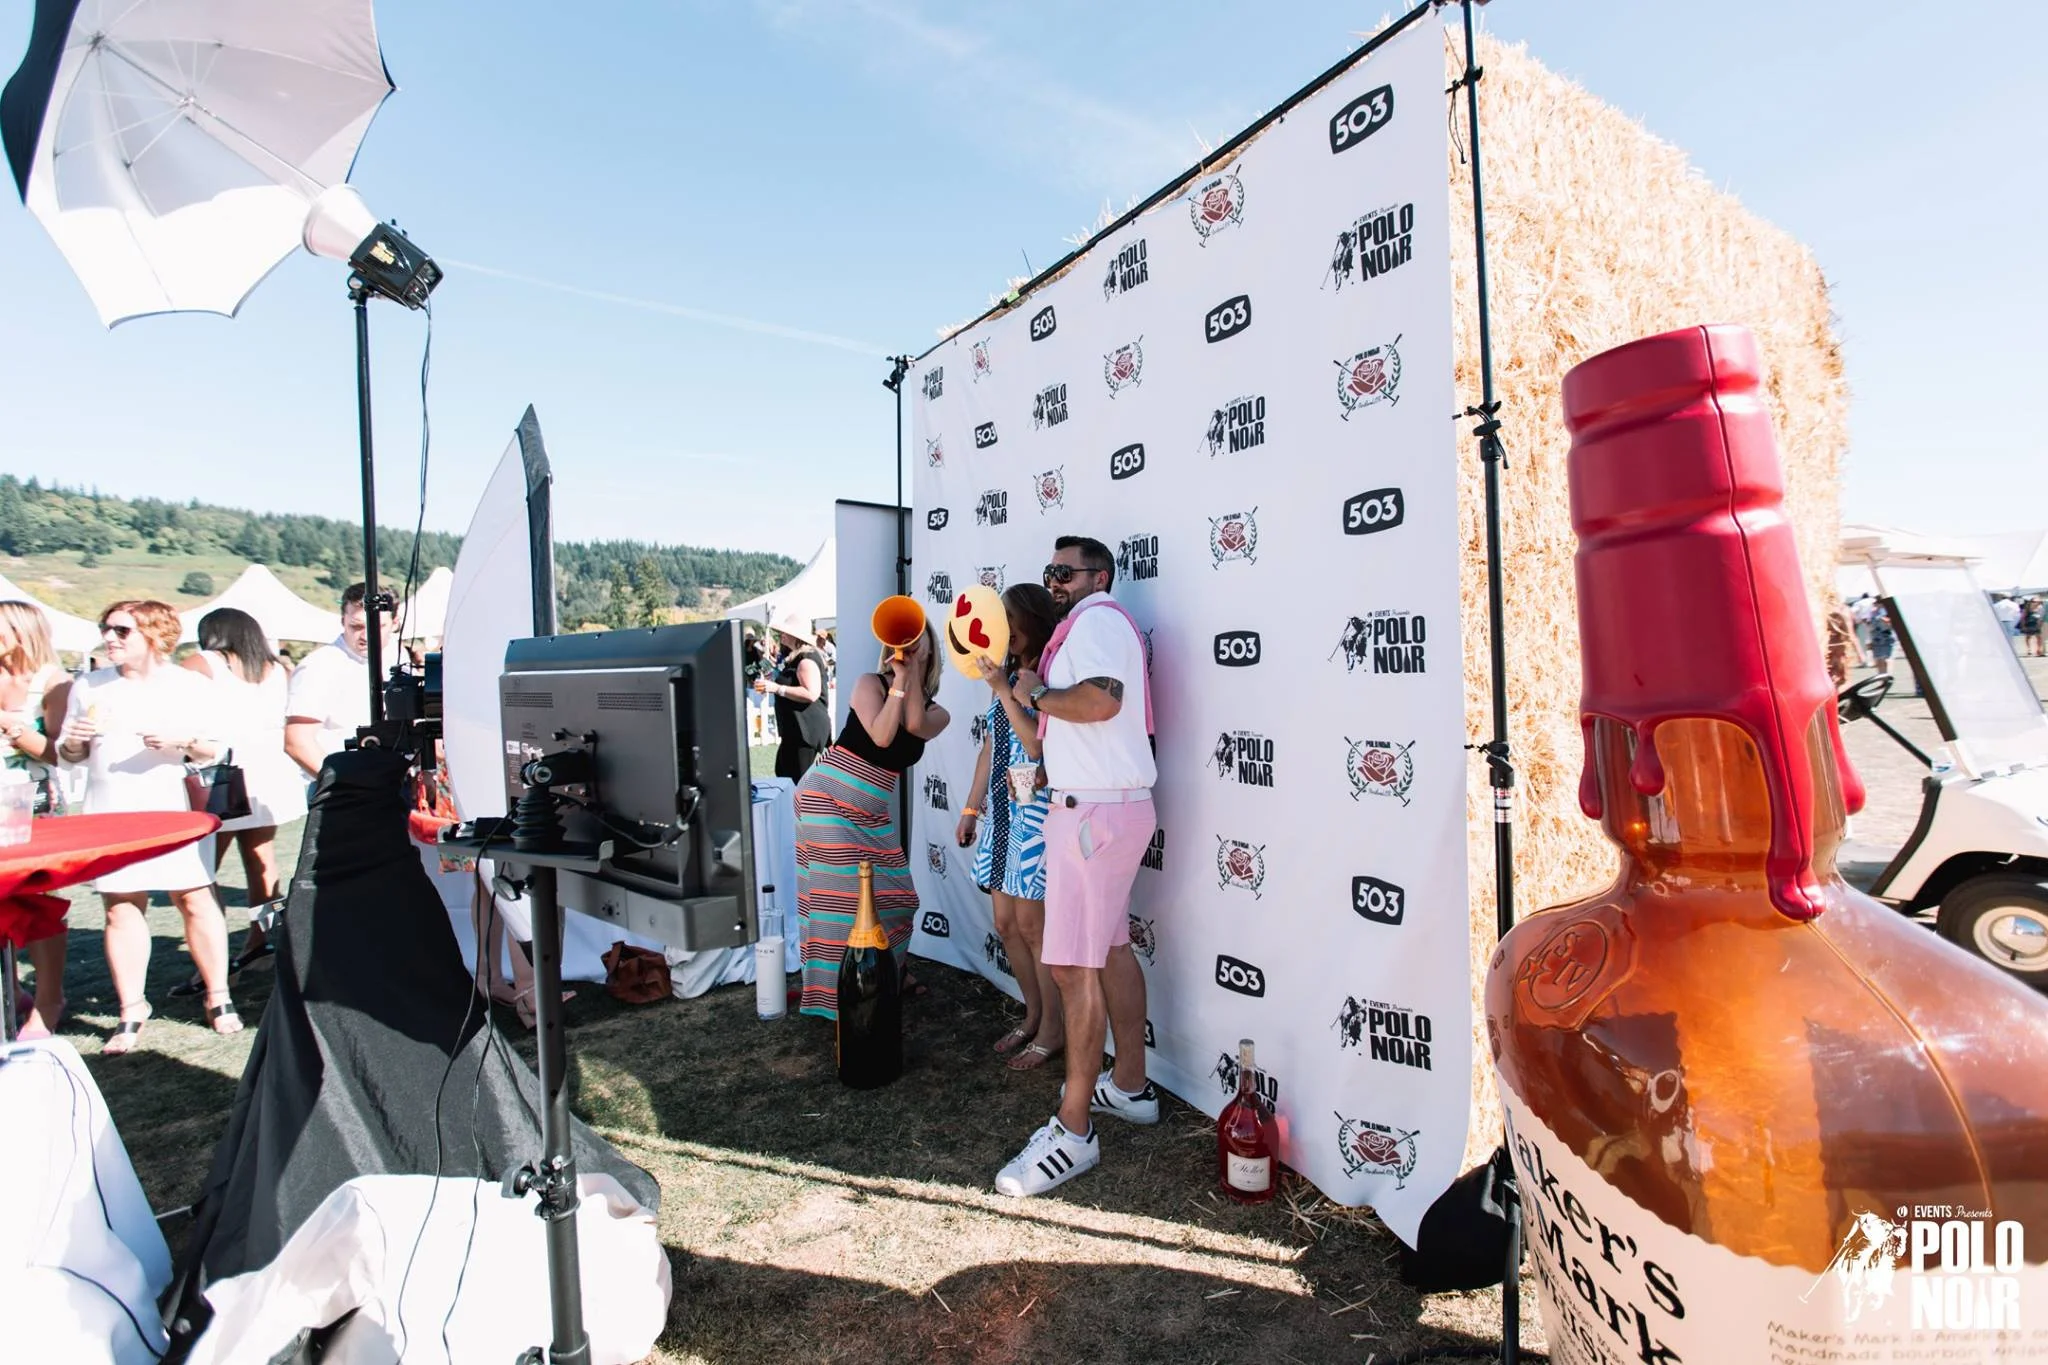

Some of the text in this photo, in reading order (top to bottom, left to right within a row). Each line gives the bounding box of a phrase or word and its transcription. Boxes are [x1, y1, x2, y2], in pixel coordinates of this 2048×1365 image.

[1336, 92, 1387, 145] 503
[1359, 203, 1413, 252] POLO
[1119, 239, 1147, 274] POLO
[1361, 234, 1412, 282] NOIR
[1120, 261, 1148, 294] NOIR
[1033, 311, 1054, 336] 503
[1210, 301, 1248, 336] 503
[1045, 383, 1066, 409] POLO
[1047, 402, 1068, 428] NOIR
[1229, 396, 1265, 430] POLO
[976, 426, 996, 445] 503
[1230, 422, 1264, 453] NOIR
[1113, 448, 1142, 474] 503
[986, 491, 1007, 510] POLO
[1349, 495, 1397, 528] 503
[1132, 536, 1158, 560] POLO
[1132, 558, 1158, 581] NOIR
[1374, 616, 1426, 645] POLO
[1218, 638, 1256, 660] 503
[1374, 645, 1426, 674] NOIR
[1238, 737, 1273, 762] POLO
[1239, 761, 1273, 787] NOIR
[1150, 828, 1164, 850] LO
[1357, 882, 1400, 917] 503
[924, 916, 948, 933] 503
[1219, 960, 1261, 992] 503
[1370, 1000, 1390, 1009] EVENTS
[1369, 1008, 1431, 1042] POLO
[1370, 1035, 1432, 1071] NOIR
[1531, 1191, 1682, 1364] Mark
[1768, 1320, 1845, 1344] Maker's
[1854, 1333, 1901, 1345] Mark
[1768, 1336, 1882, 1361] handmade
